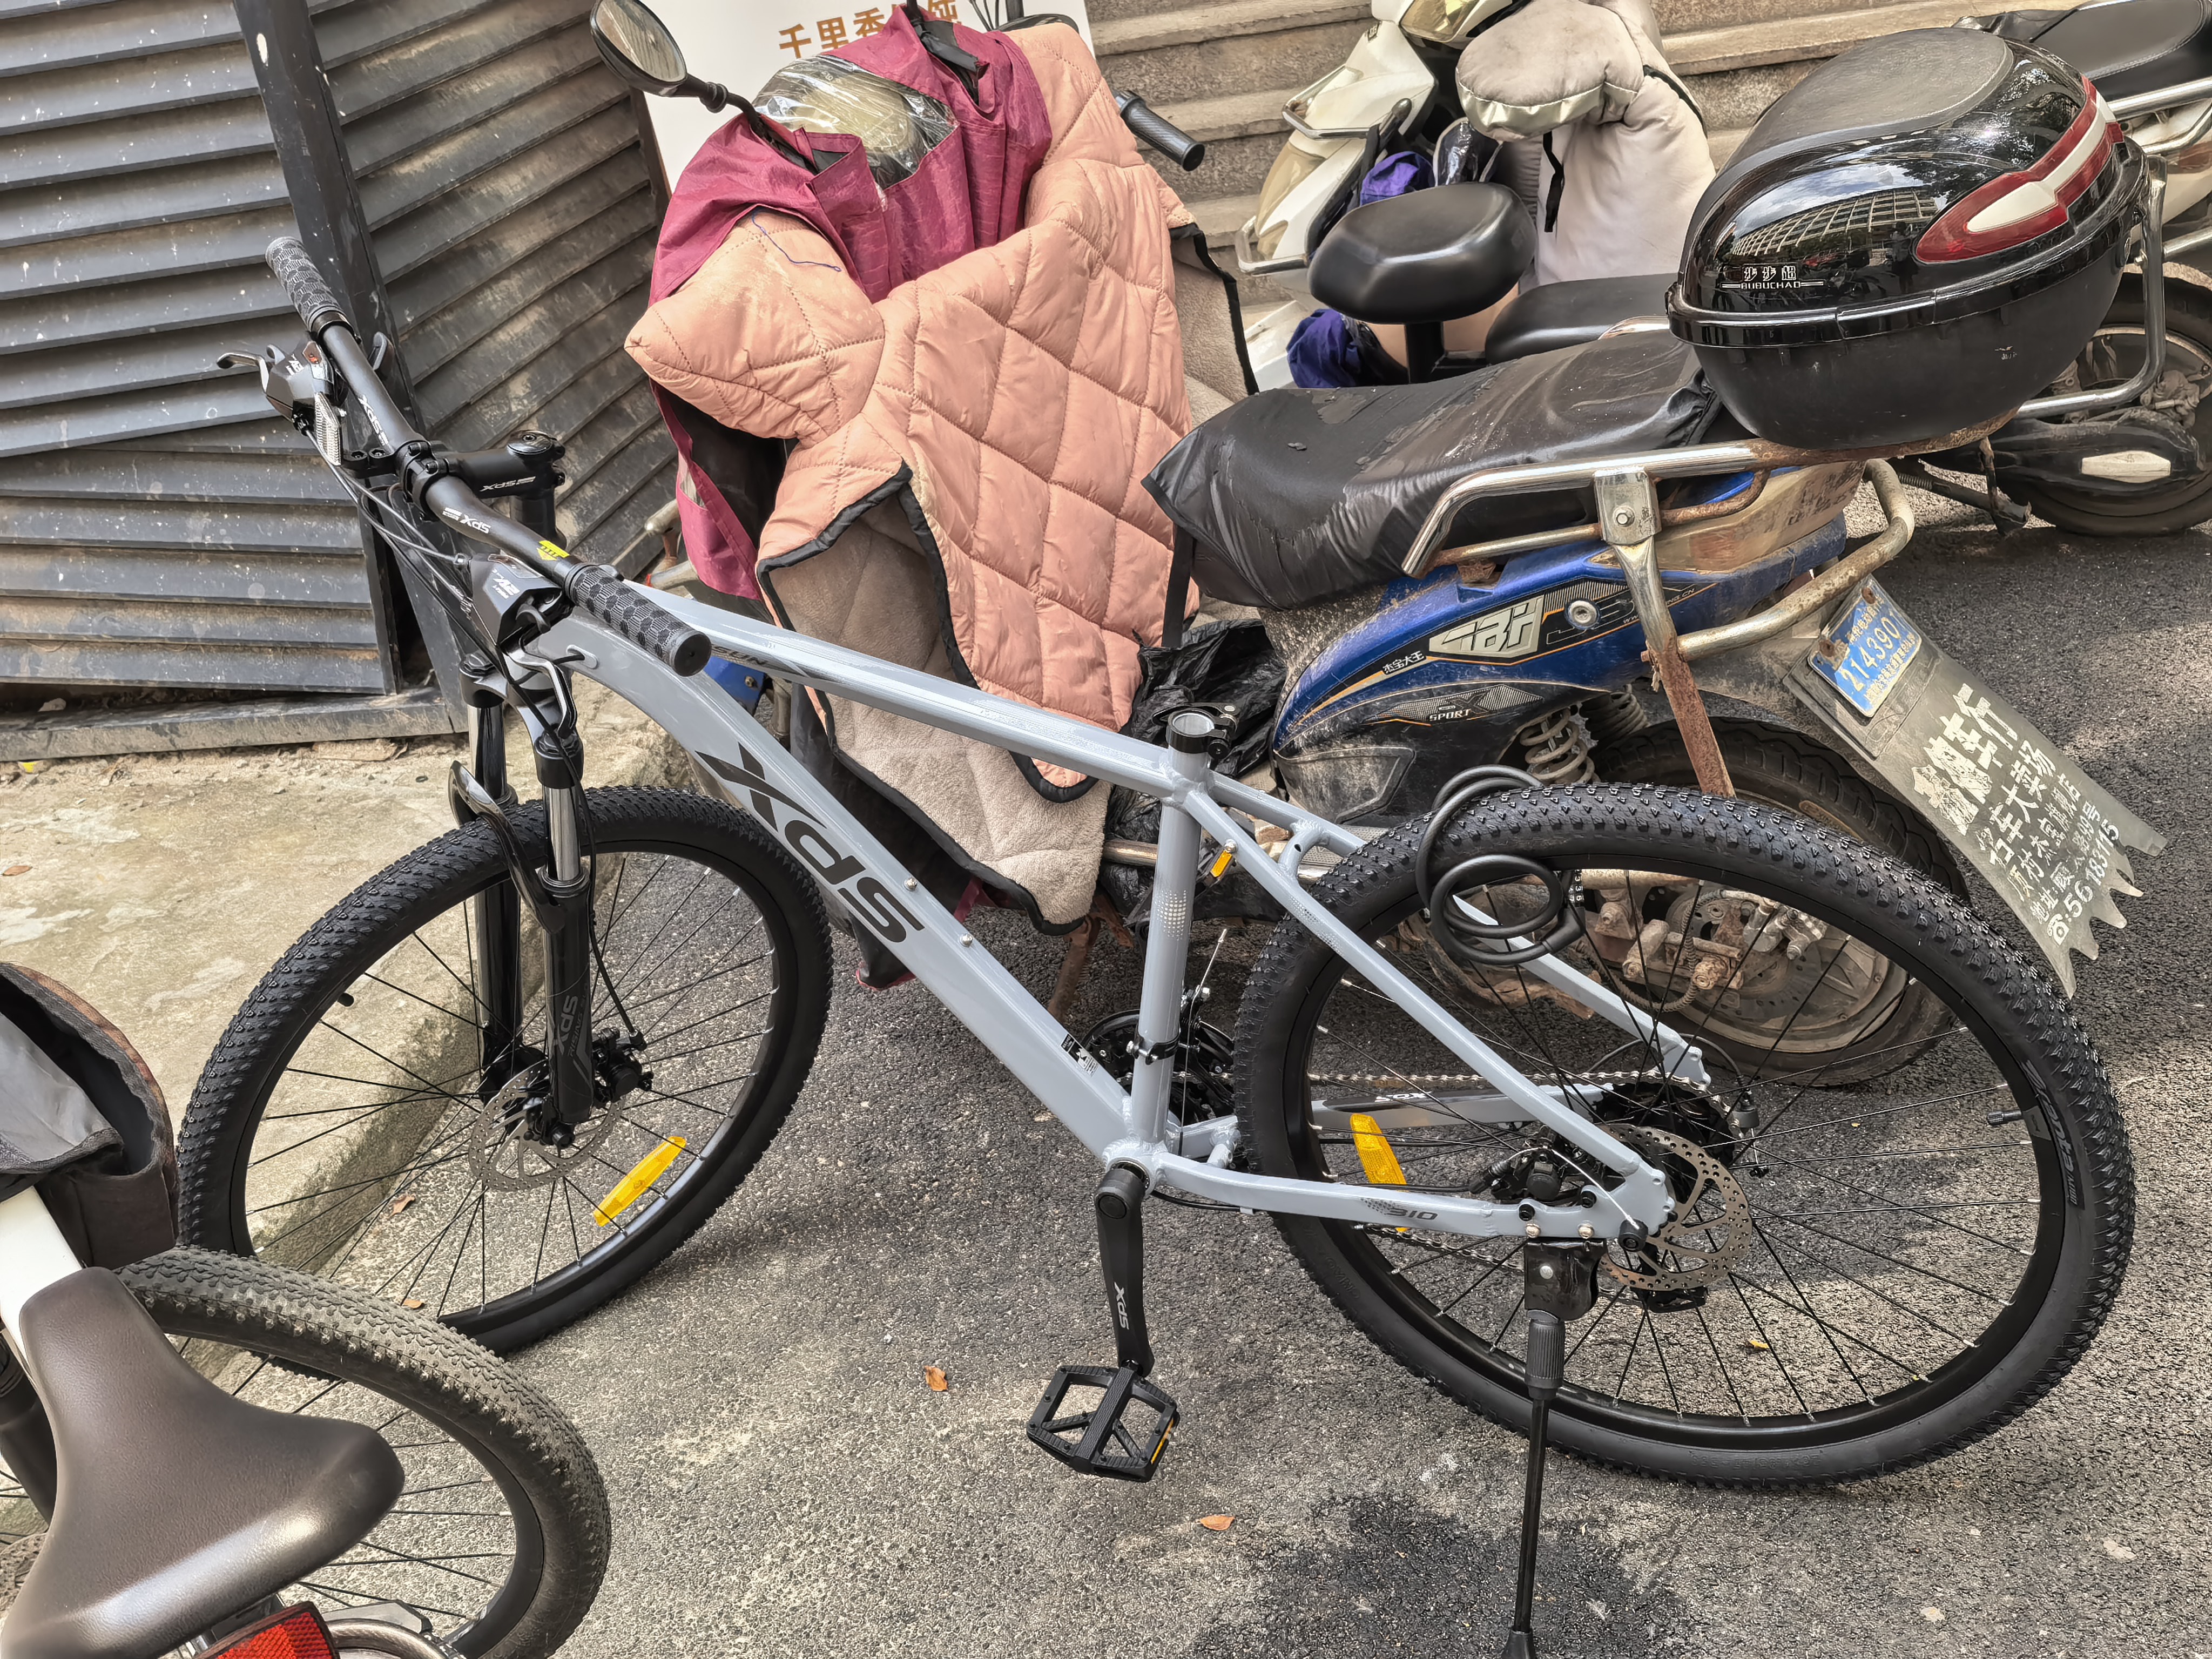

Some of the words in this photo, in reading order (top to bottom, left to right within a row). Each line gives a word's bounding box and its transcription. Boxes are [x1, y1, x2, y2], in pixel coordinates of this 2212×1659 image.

[1382, 650, 1424, 674] 杰宝大王
[1429, 708, 1472, 721] SPORT
[1975, 740, 2056, 868] 名车大卖场
